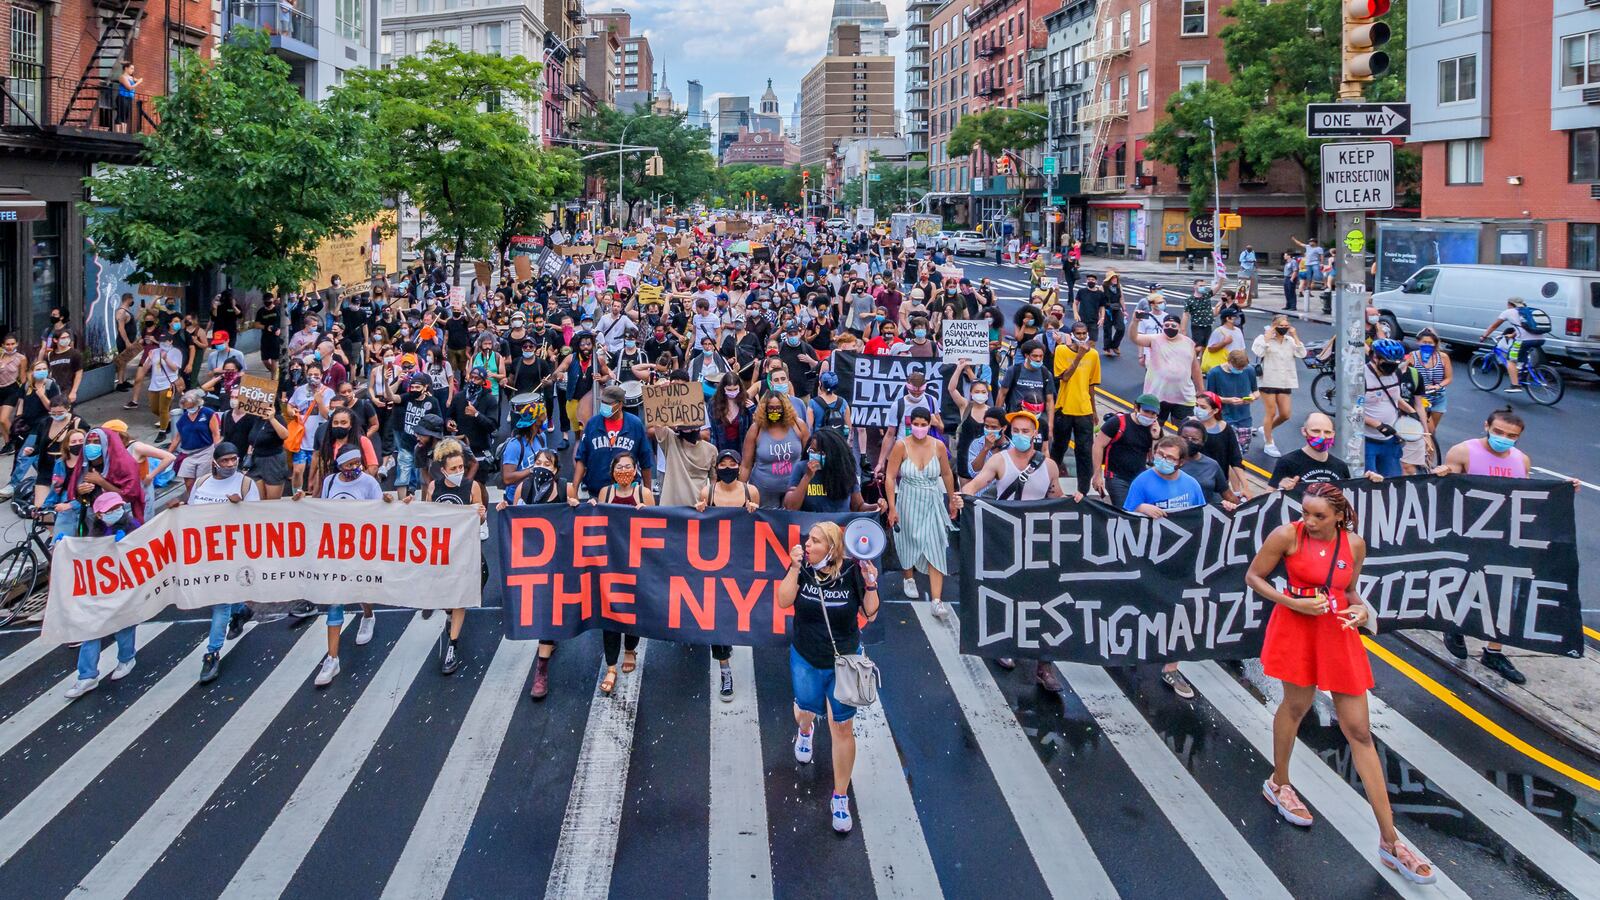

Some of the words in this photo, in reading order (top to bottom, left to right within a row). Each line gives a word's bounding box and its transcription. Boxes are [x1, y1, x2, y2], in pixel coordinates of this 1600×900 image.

[1323, 114, 1352, 127] ONE
[1365, 114, 1396, 127] WAY
[1339, 150, 1375, 164] KEEP
[1326, 169, 1390, 184] INTERSECTION
[1335, 188, 1381, 203] CLEAR
[949, 322, 978, 330] ANGRY
[945, 330, 965, 338] ASIAN
[877, 347, 891, 355] BLA
[944, 339, 967, 347] BLACK
[968, 340, 988, 348] LIVES
[854, 357, 944, 380] BLACK
[240, 386, 275, 403] PEOPLE
[646, 383, 690, 398] DEFUND
[855, 381, 940, 403] LIVS
[645, 402, 706, 423] BASTARDS
[851, 406, 894, 427] MAT
[770, 442, 793, 455] LOVE
[776, 453, 791, 461] TO
[1489, 466, 1513, 477] LOVE
[807, 484, 827, 496] ABOL
[510, 515, 801, 573] DEFUN
[974, 499, 1193, 581] DEFUND
[72, 529, 177, 597] DISARM
[182, 521, 306, 566] DEFUND
[317, 522, 452, 566] ABOLISH
[262, 570, 383, 583] DEFUNDNYPD.COM
[506, 573, 637, 627] THE
[668, 576, 797, 634] NYP
[978, 585, 1263, 660] DESTIGMATIZE
